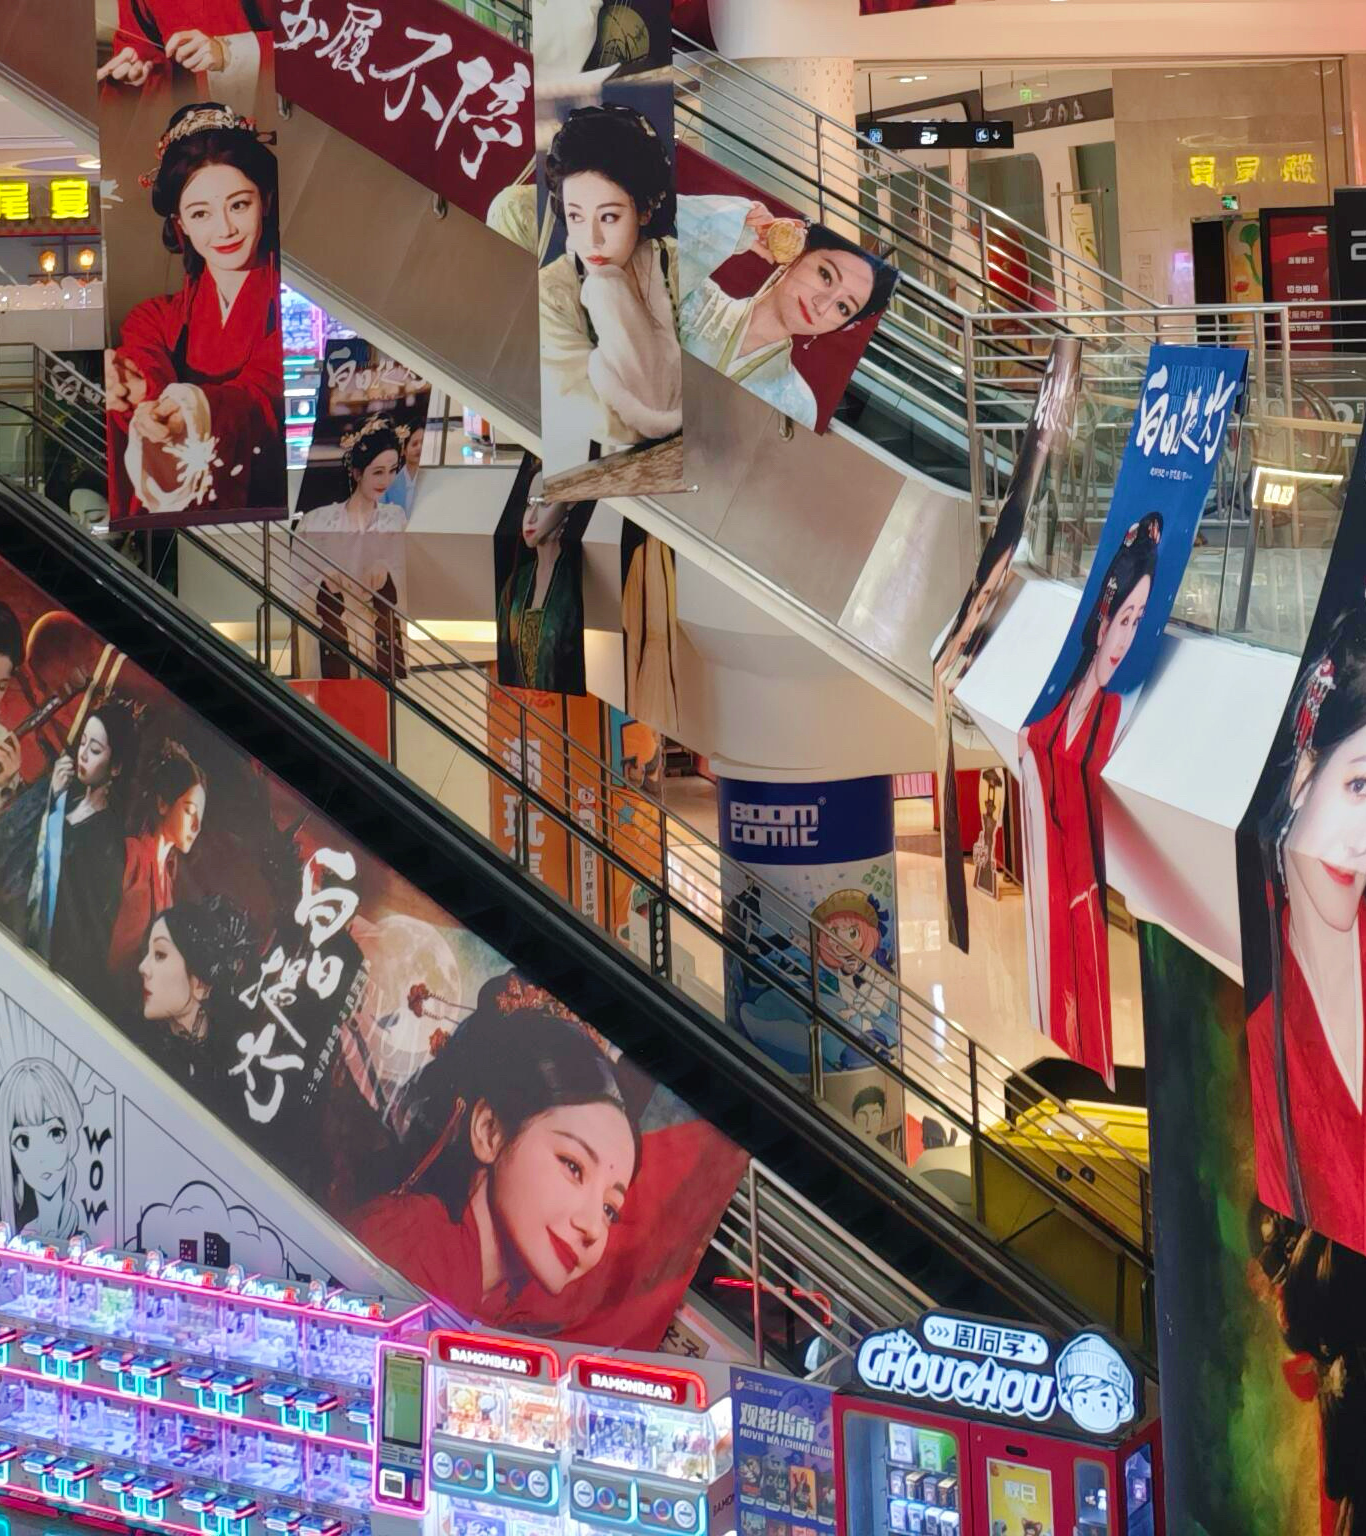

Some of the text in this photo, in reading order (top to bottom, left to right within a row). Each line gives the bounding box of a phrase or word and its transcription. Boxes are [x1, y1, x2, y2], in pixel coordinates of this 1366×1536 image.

[1137, 365, 1236, 464] 白日提灯
[730, 800, 819, 826] BOOM
[731, 821, 819, 846] COMIC
[228, 847, 359, 1124] 白日提灯
[81, 1125, 113, 1227] WOW
[953, 1322, 1027, 1358] 周同学
[449, 1347, 527, 1375] DAMONBEAR
[858, 1332, 1056, 1421] CHOUCHOU
[590, 1373, 673, 1402] DAMONBEAR
[739, 1402, 816, 1443] 观影指南
[740, 1427, 764, 1444] MOVIE
